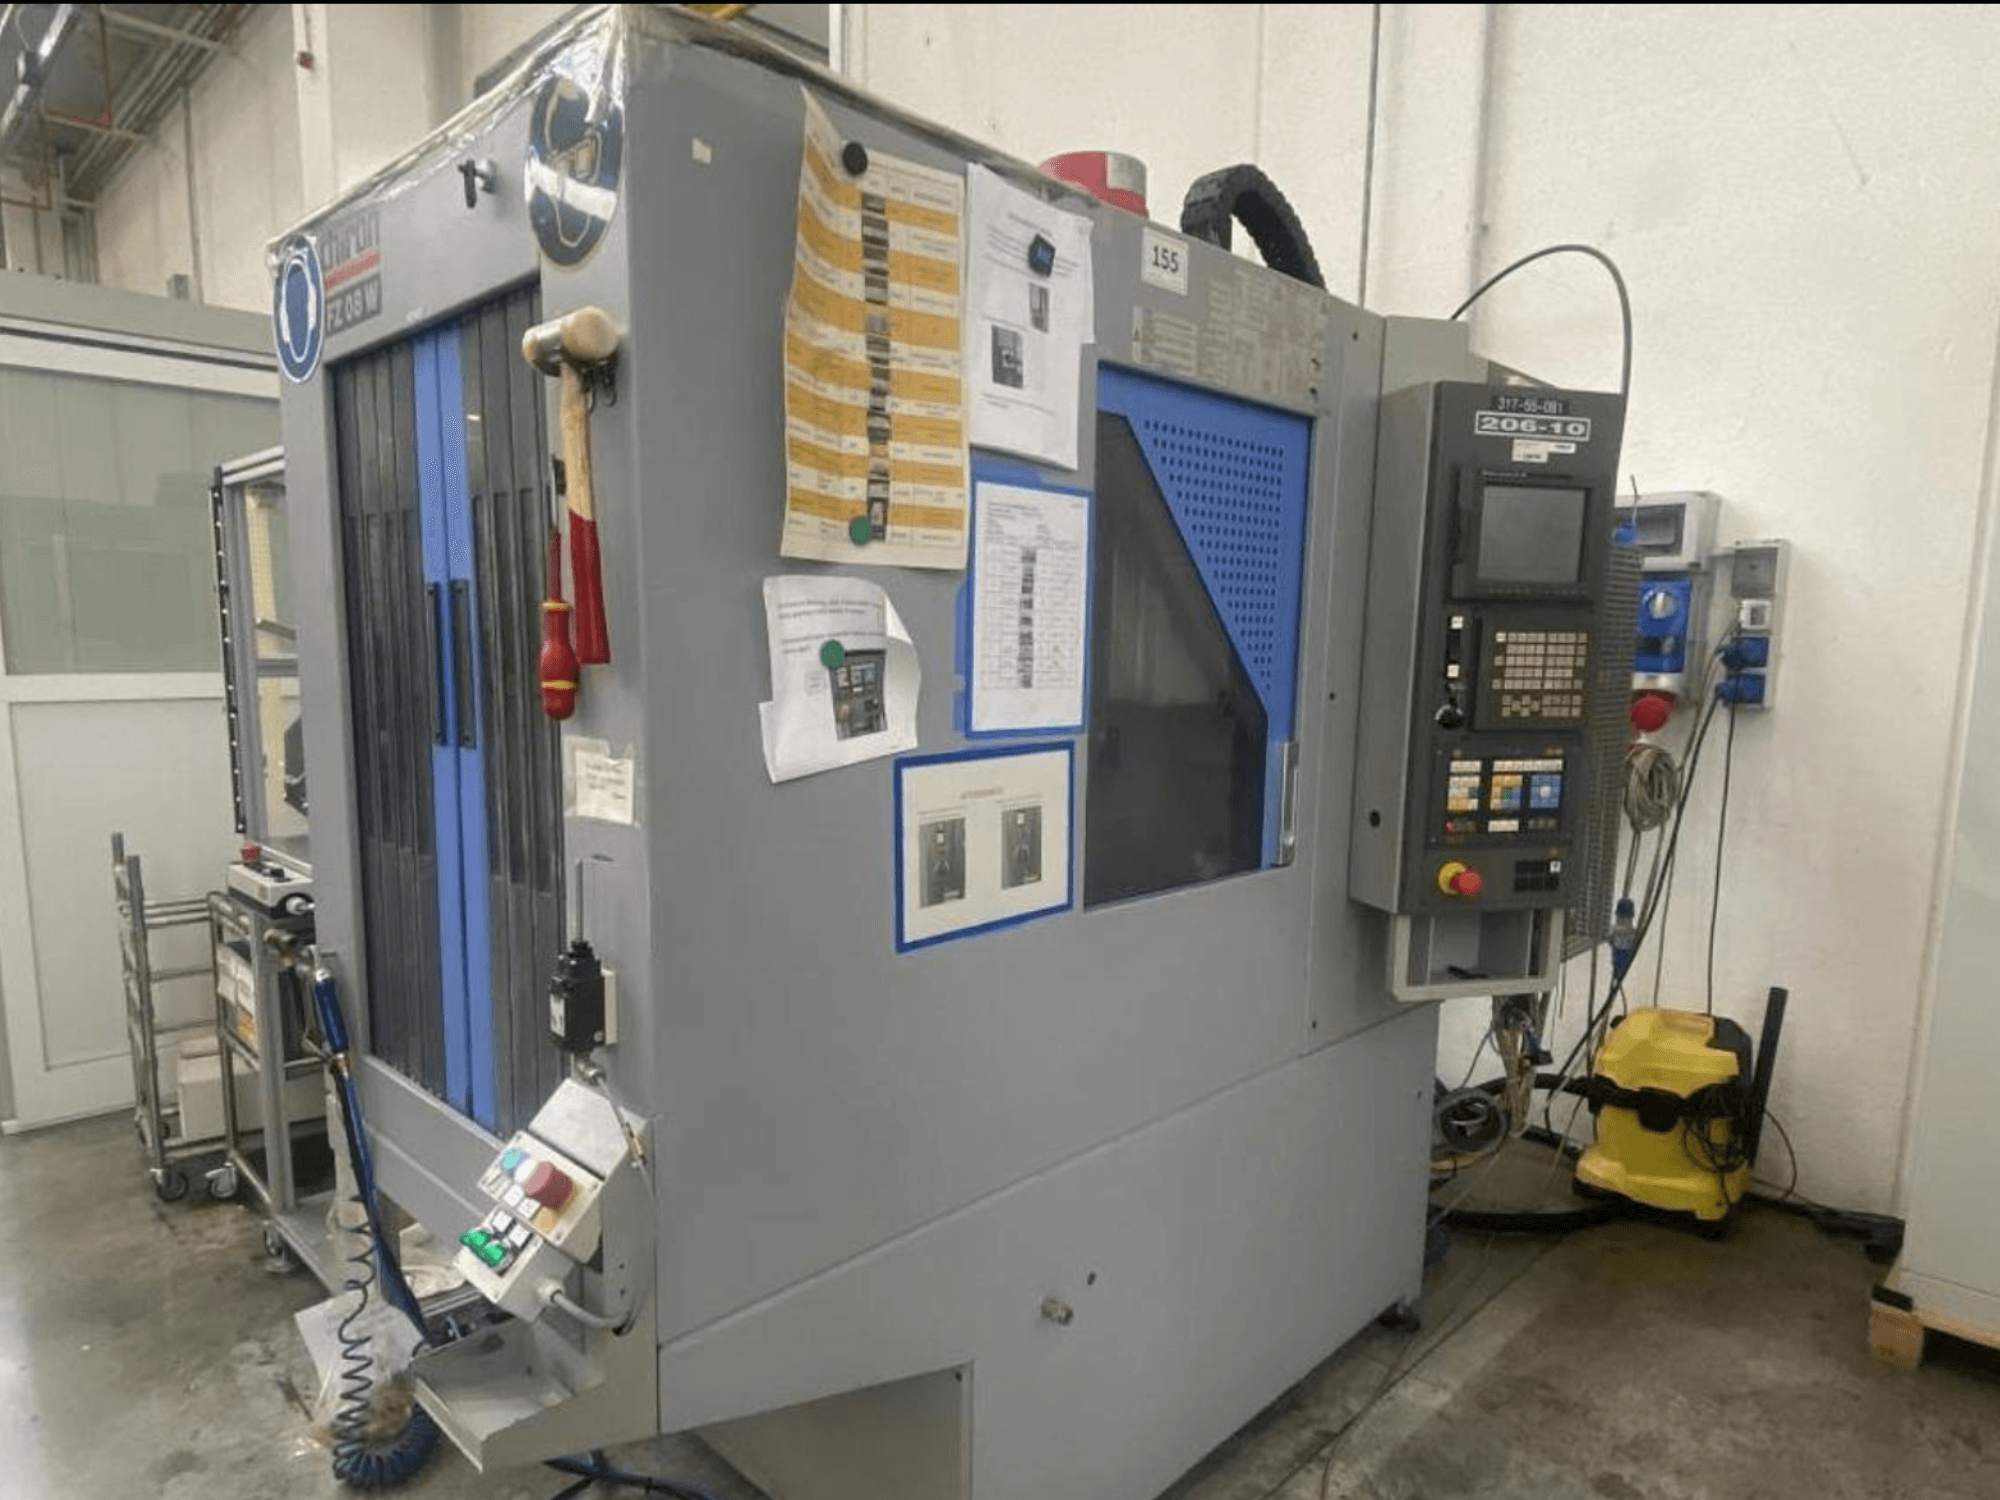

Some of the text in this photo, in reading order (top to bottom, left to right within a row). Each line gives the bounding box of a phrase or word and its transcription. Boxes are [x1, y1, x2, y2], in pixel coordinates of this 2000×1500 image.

[1152, 245, 1179, 274] 155
[327, 299, 344, 332] FZ
[364, 279, 380, 313] W
[1480, 416, 1586, 436] 206-10
